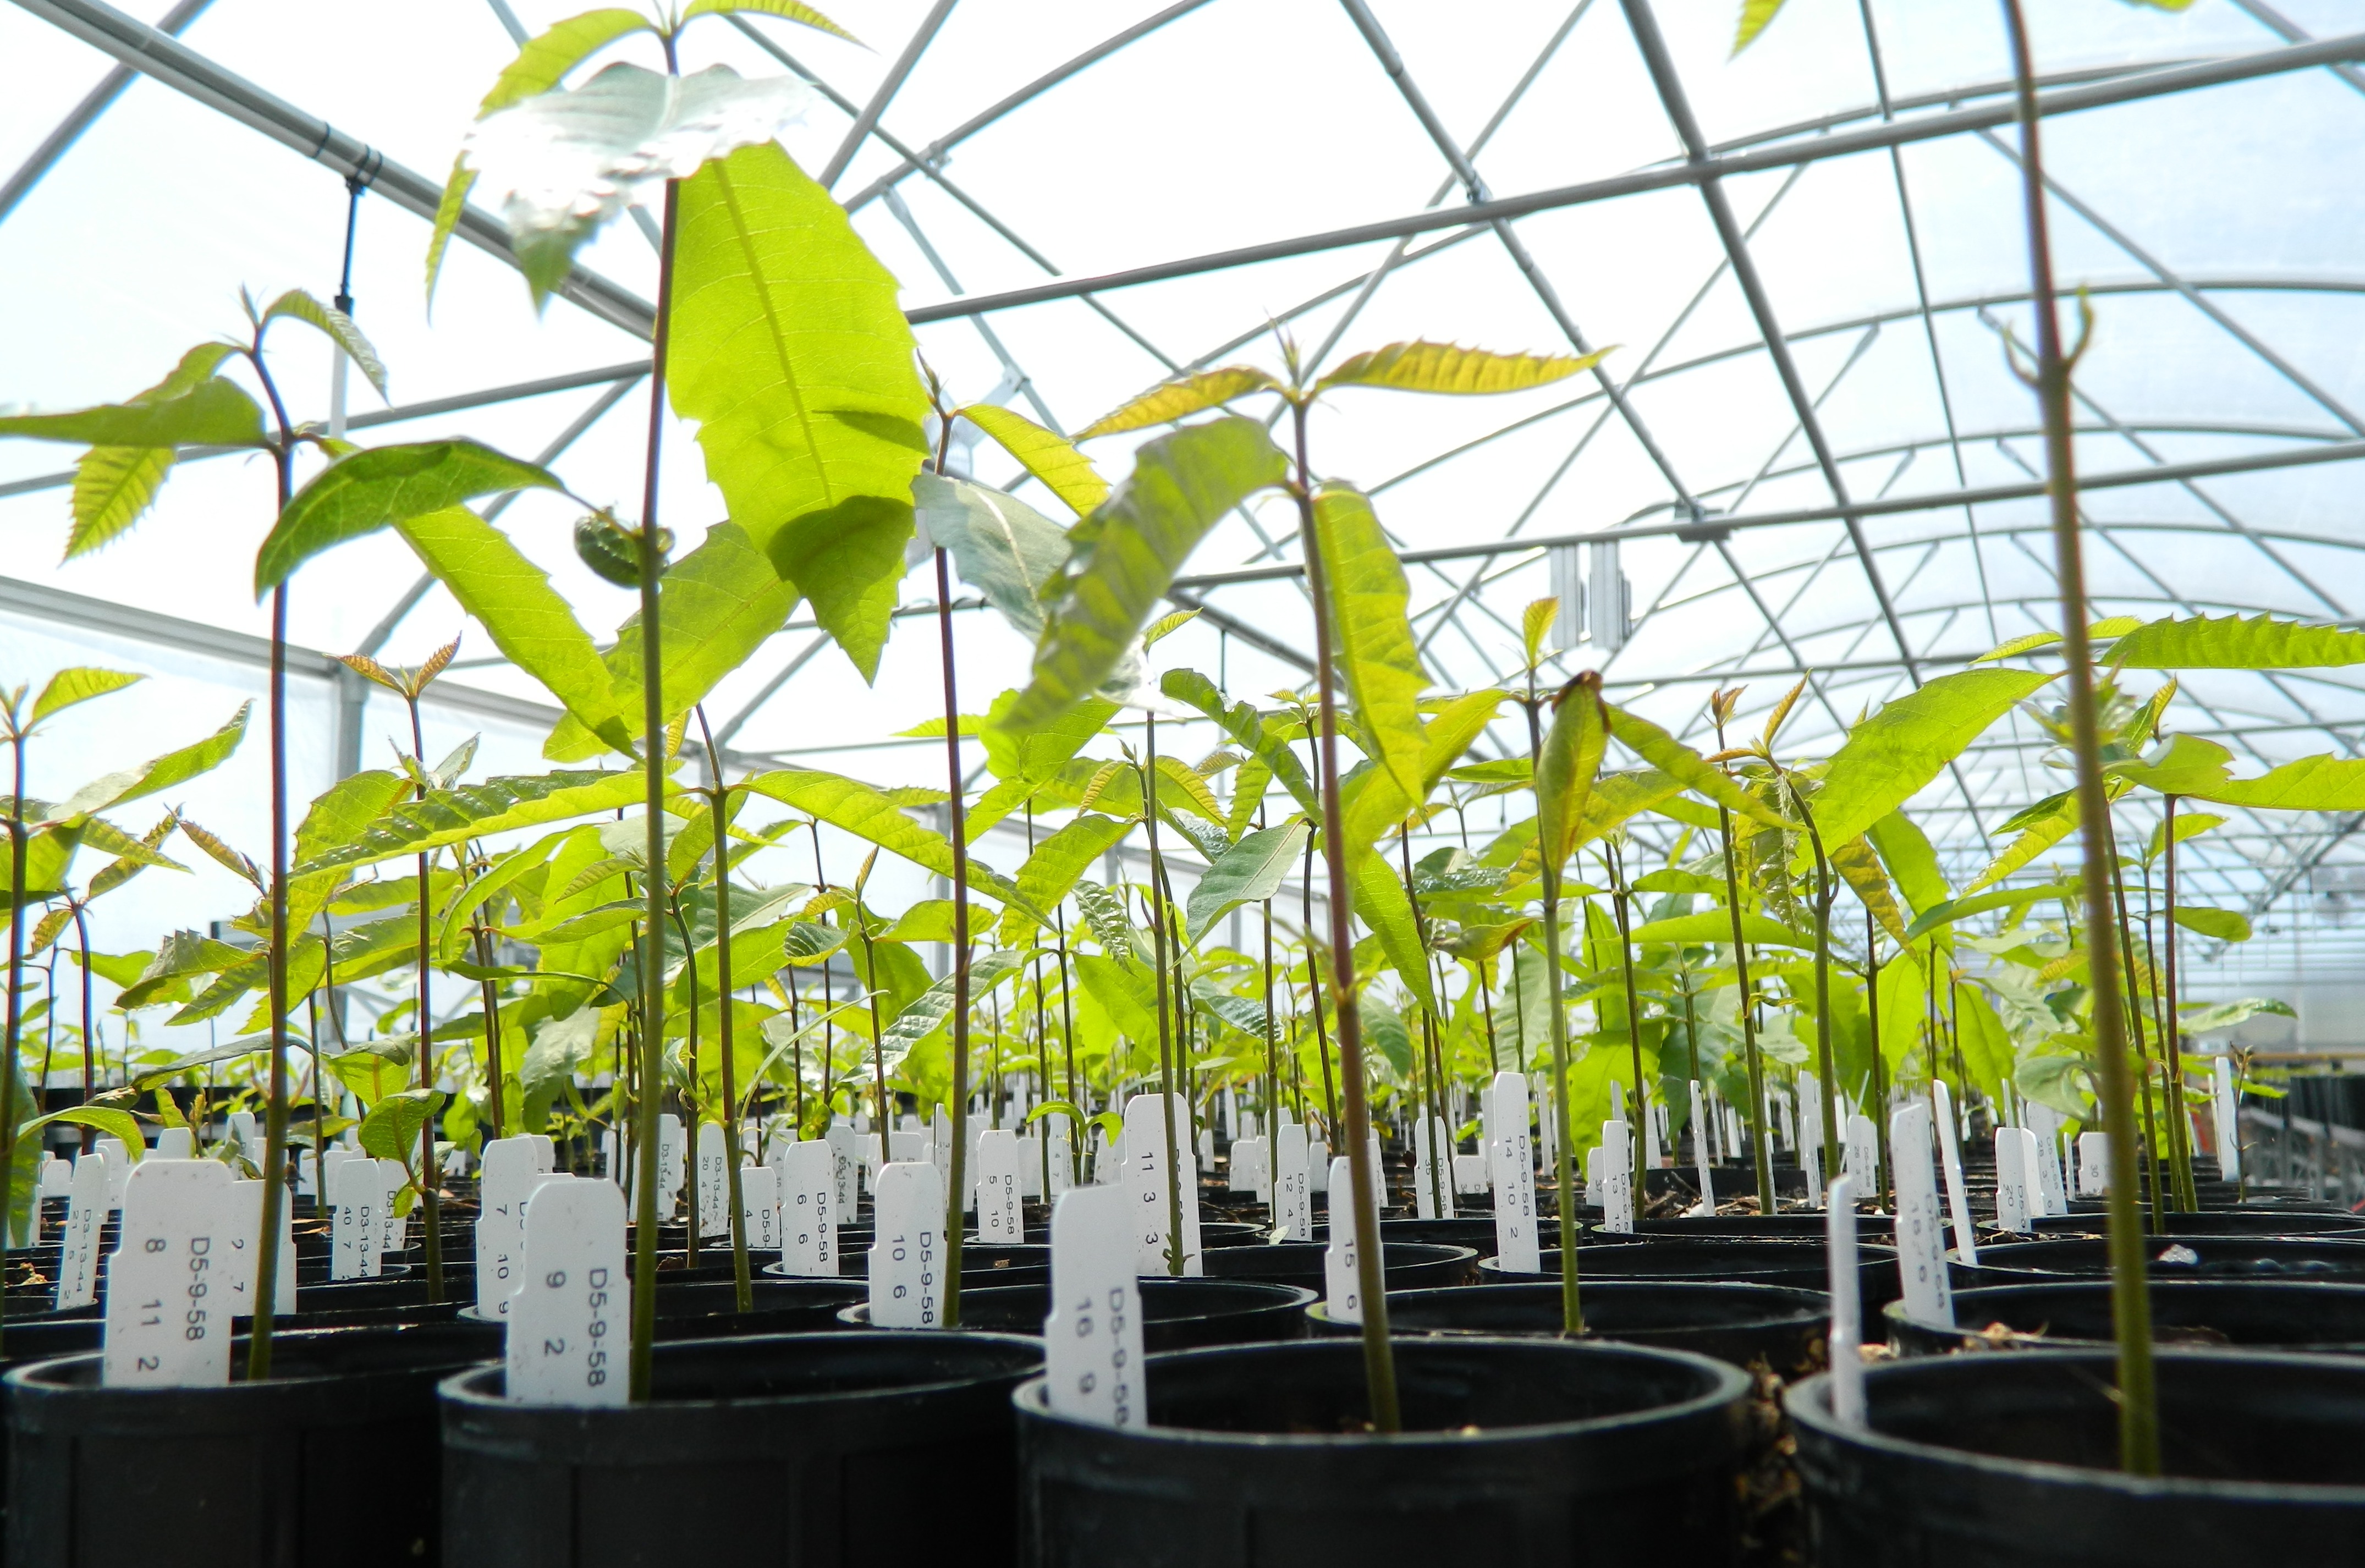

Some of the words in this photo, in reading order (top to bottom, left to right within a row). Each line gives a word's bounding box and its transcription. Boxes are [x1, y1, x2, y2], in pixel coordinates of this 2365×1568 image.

[1505, 1136, 1513, 1159] 14
[658, 1143, 669, 1189] D3-13-44
[701, 1156, 710, 1171] 20
[1141, 1152, 1154, 1171] 11
[2090, 1164, 2099, 1178] 30
[713, 1156, 722, 1209] D3-13-44
[837, 1156, 847, 1204] D3-13-44
[989, 1175, 997, 1184] 5
[1285, 1174, 1293, 1192] 12
[1437, 1157, 1448, 1212] D5-9-58
[1519, 1135, 1530, 1217] D5-9-58
[1508, 1182, 1516, 1206] 10
[1595, 1180, 1603, 1193] 37
[797, 1193, 807, 1205] 6
[1005, 1175, 1015, 1235] D5-9-58
[1143, 1192, 1156, 1203] 3
[1297, 1173, 1306, 1237] D5-9-58
[1612, 1175, 1618, 1195] 13
[1615, 1214, 1620, 1233] 10
[343, 1207, 352, 1225] 40
[496, 1203, 508, 1216] 7
[744, 1210, 754, 1219] 4
[991, 1210, 999, 1228] 10
[1287, 1208, 1294, 1218] 4
[72, 1210, 79, 1230] 21
[382, 1191, 397, 1249] D3-13-44
[816, 1192, 828, 1263] D5-9-58
[359, 1206, 370, 1277] D3-13-44
[798, 1233, 809, 1245] 6
[1146, 1231, 1158, 1245] 3
[1510, 1227, 1518, 1239] 2
[76, 1209, 92, 1292] D3-13-44
[145, 1238, 166, 1253] 8
[343, 1241, 351, 1249] 7
[892, 1234, 906, 1261] 10
[1344, 1238, 1356, 1267] 15
[498, 1254, 509, 1279] 10
[233, 1281, 244, 1292] 7
[546, 1270, 566, 1289] 9
[919, 1231, 934, 1324] D5-9-58
[64, 1290, 70, 1300] 2
[186, 1237, 210, 1341] D5-9-58
[893, 1285, 906, 1299] 6
[498, 1301, 509, 1314] 9
[1347, 1294, 1357, 1310] 6
[140, 1299, 162, 1327] 11
[587, 1268, 608, 1387] D5-9-58
[544, 1338, 565, 1357] 2
[138, 1355, 160, 1372] 2
[1109, 1288, 1130, 1428] D5-9-58
